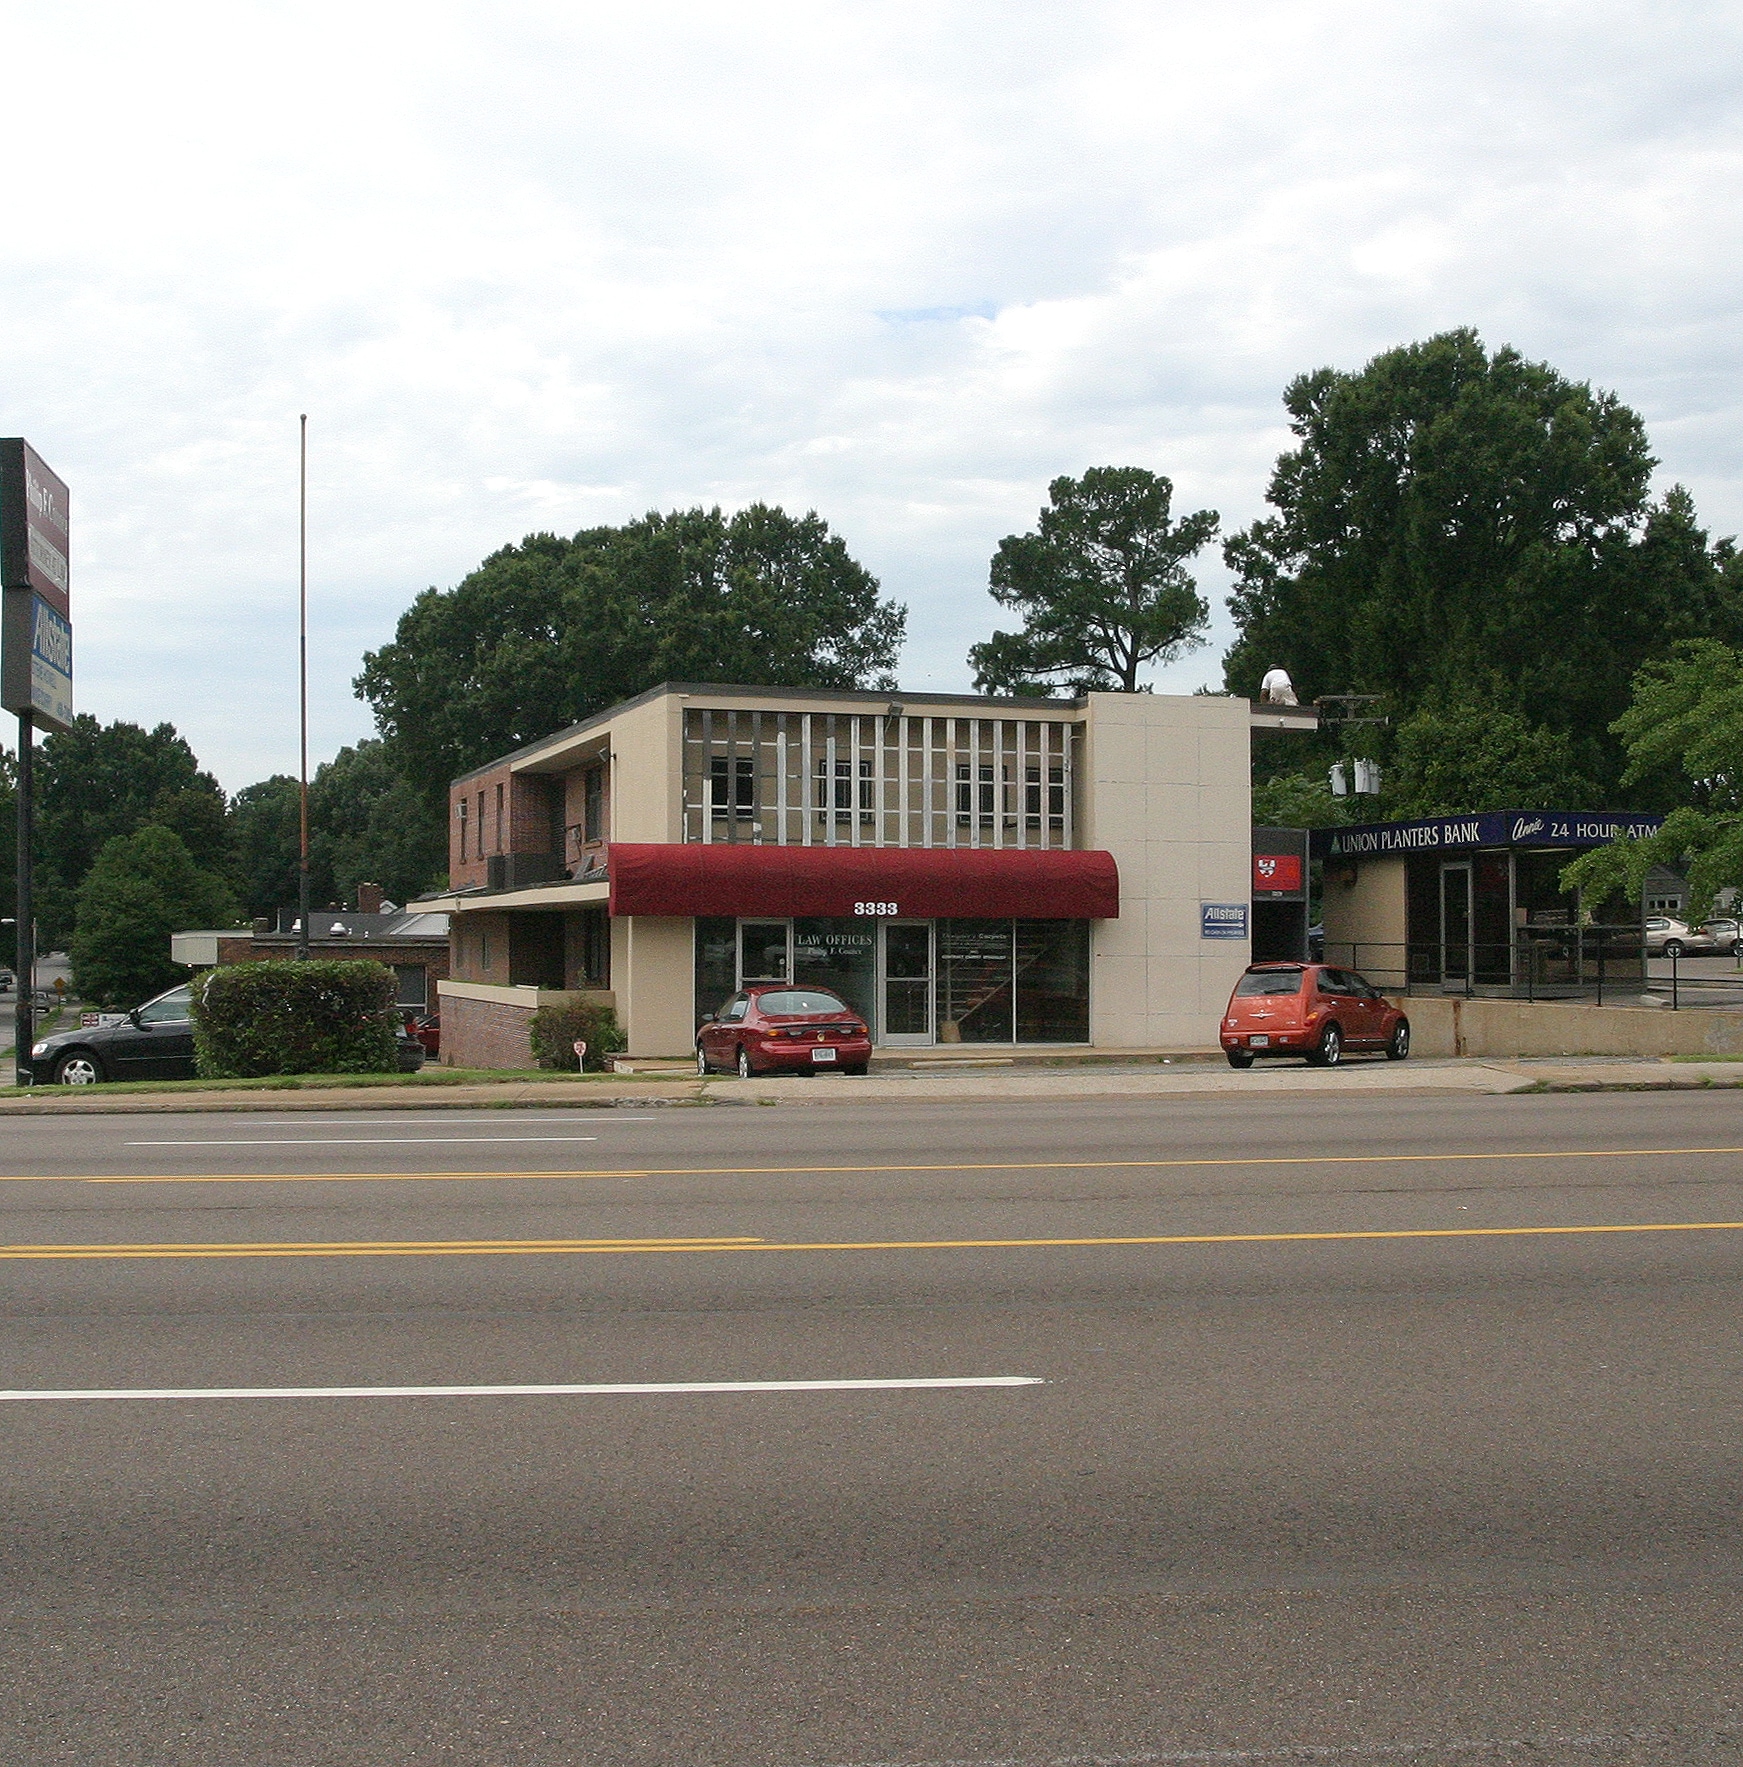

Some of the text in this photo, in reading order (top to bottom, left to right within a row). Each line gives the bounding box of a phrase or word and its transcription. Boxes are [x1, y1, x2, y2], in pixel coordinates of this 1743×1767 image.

[1342, 821, 1481, 853] UNION PLANTERS BANK
[1551, 823, 1570, 838] 24
[1627, 824, 1658, 839] ATM
[854, 902, 898, 916] 3333
[1204, 907, 1245, 920] Allstate
[798, 934, 873, 946] LAW OFFICES
